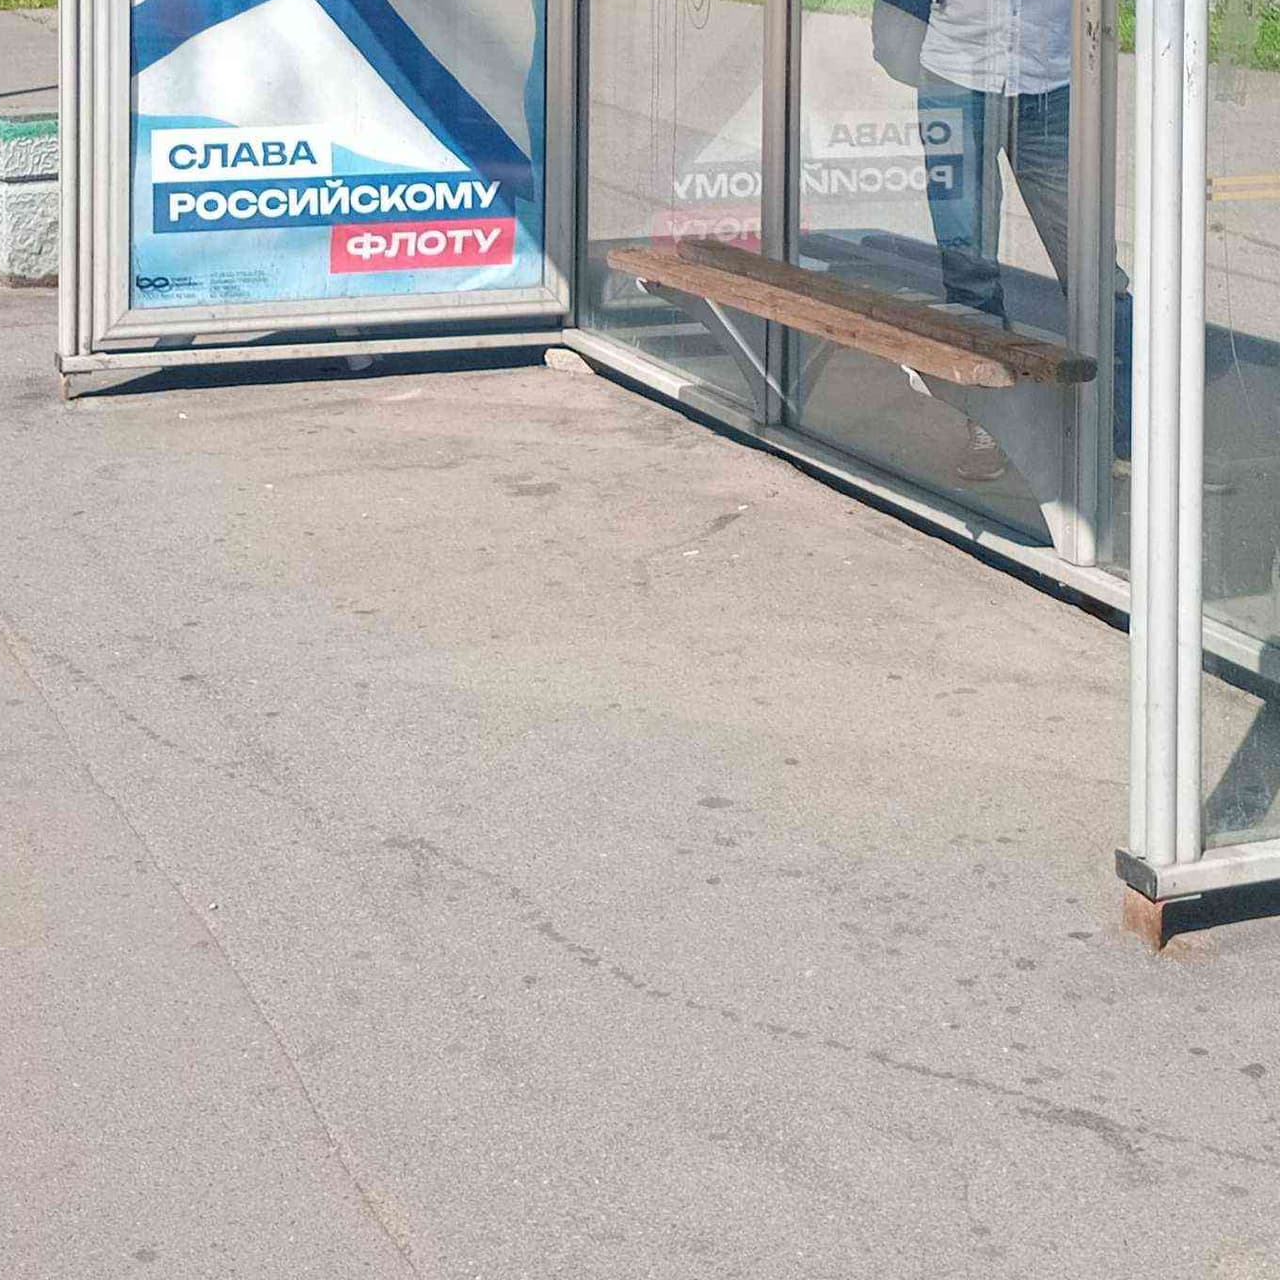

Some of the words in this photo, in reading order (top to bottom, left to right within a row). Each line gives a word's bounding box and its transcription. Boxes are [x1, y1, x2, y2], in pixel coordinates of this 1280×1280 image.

[168, 140, 318, 170] СЛАВА
[169, 179, 501, 222] РОССИЙСКОМУ
[346, 228, 501, 261] ФЛОТУ
